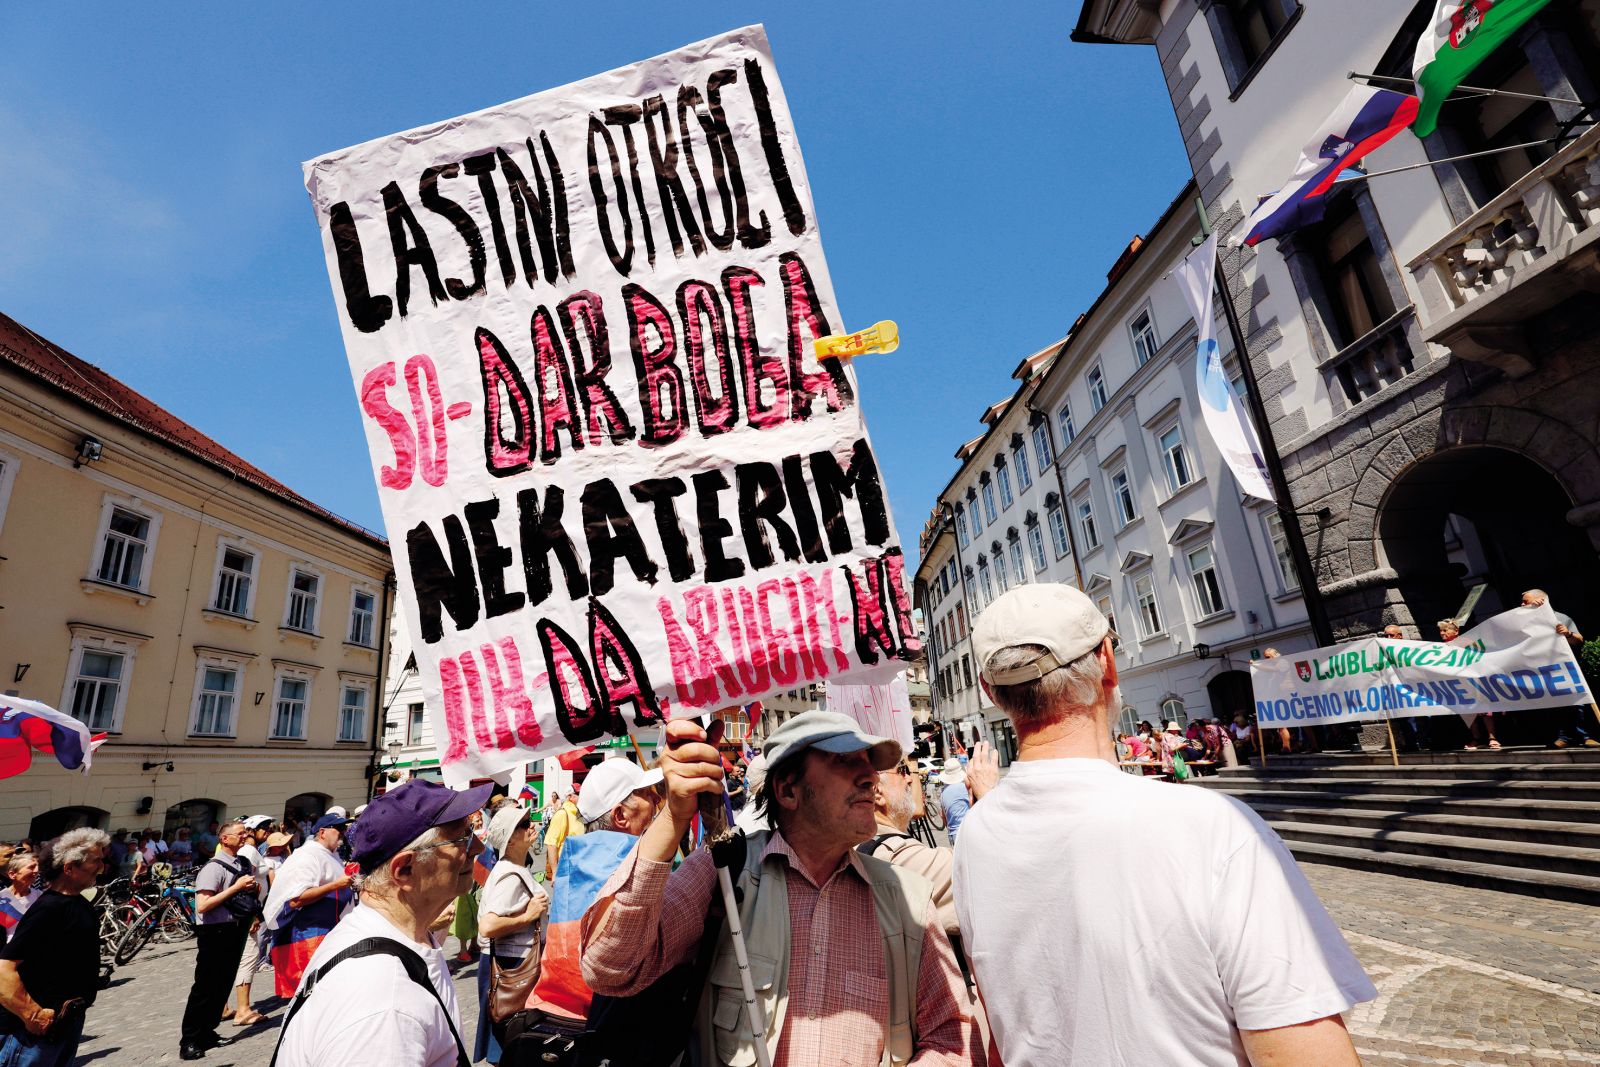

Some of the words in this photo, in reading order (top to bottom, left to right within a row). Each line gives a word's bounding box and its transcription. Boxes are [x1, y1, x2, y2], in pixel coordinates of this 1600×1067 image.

[330, 130, 576, 333] LASTNI
[588, 58, 806, 277] OTROCI
[474, 289, 637, 479] DAR
[621, 251, 855, 448] BOGA
[407, 438, 890, 643] NEKATERIM
[1256, 692, 1342, 722] NOČEMO
[1344, 678, 1476, 713] KLORIRANE
[1467, 662, 1585, 702] VODE!
[1313, 639, 1486, 681] LJUBLJANČANI
